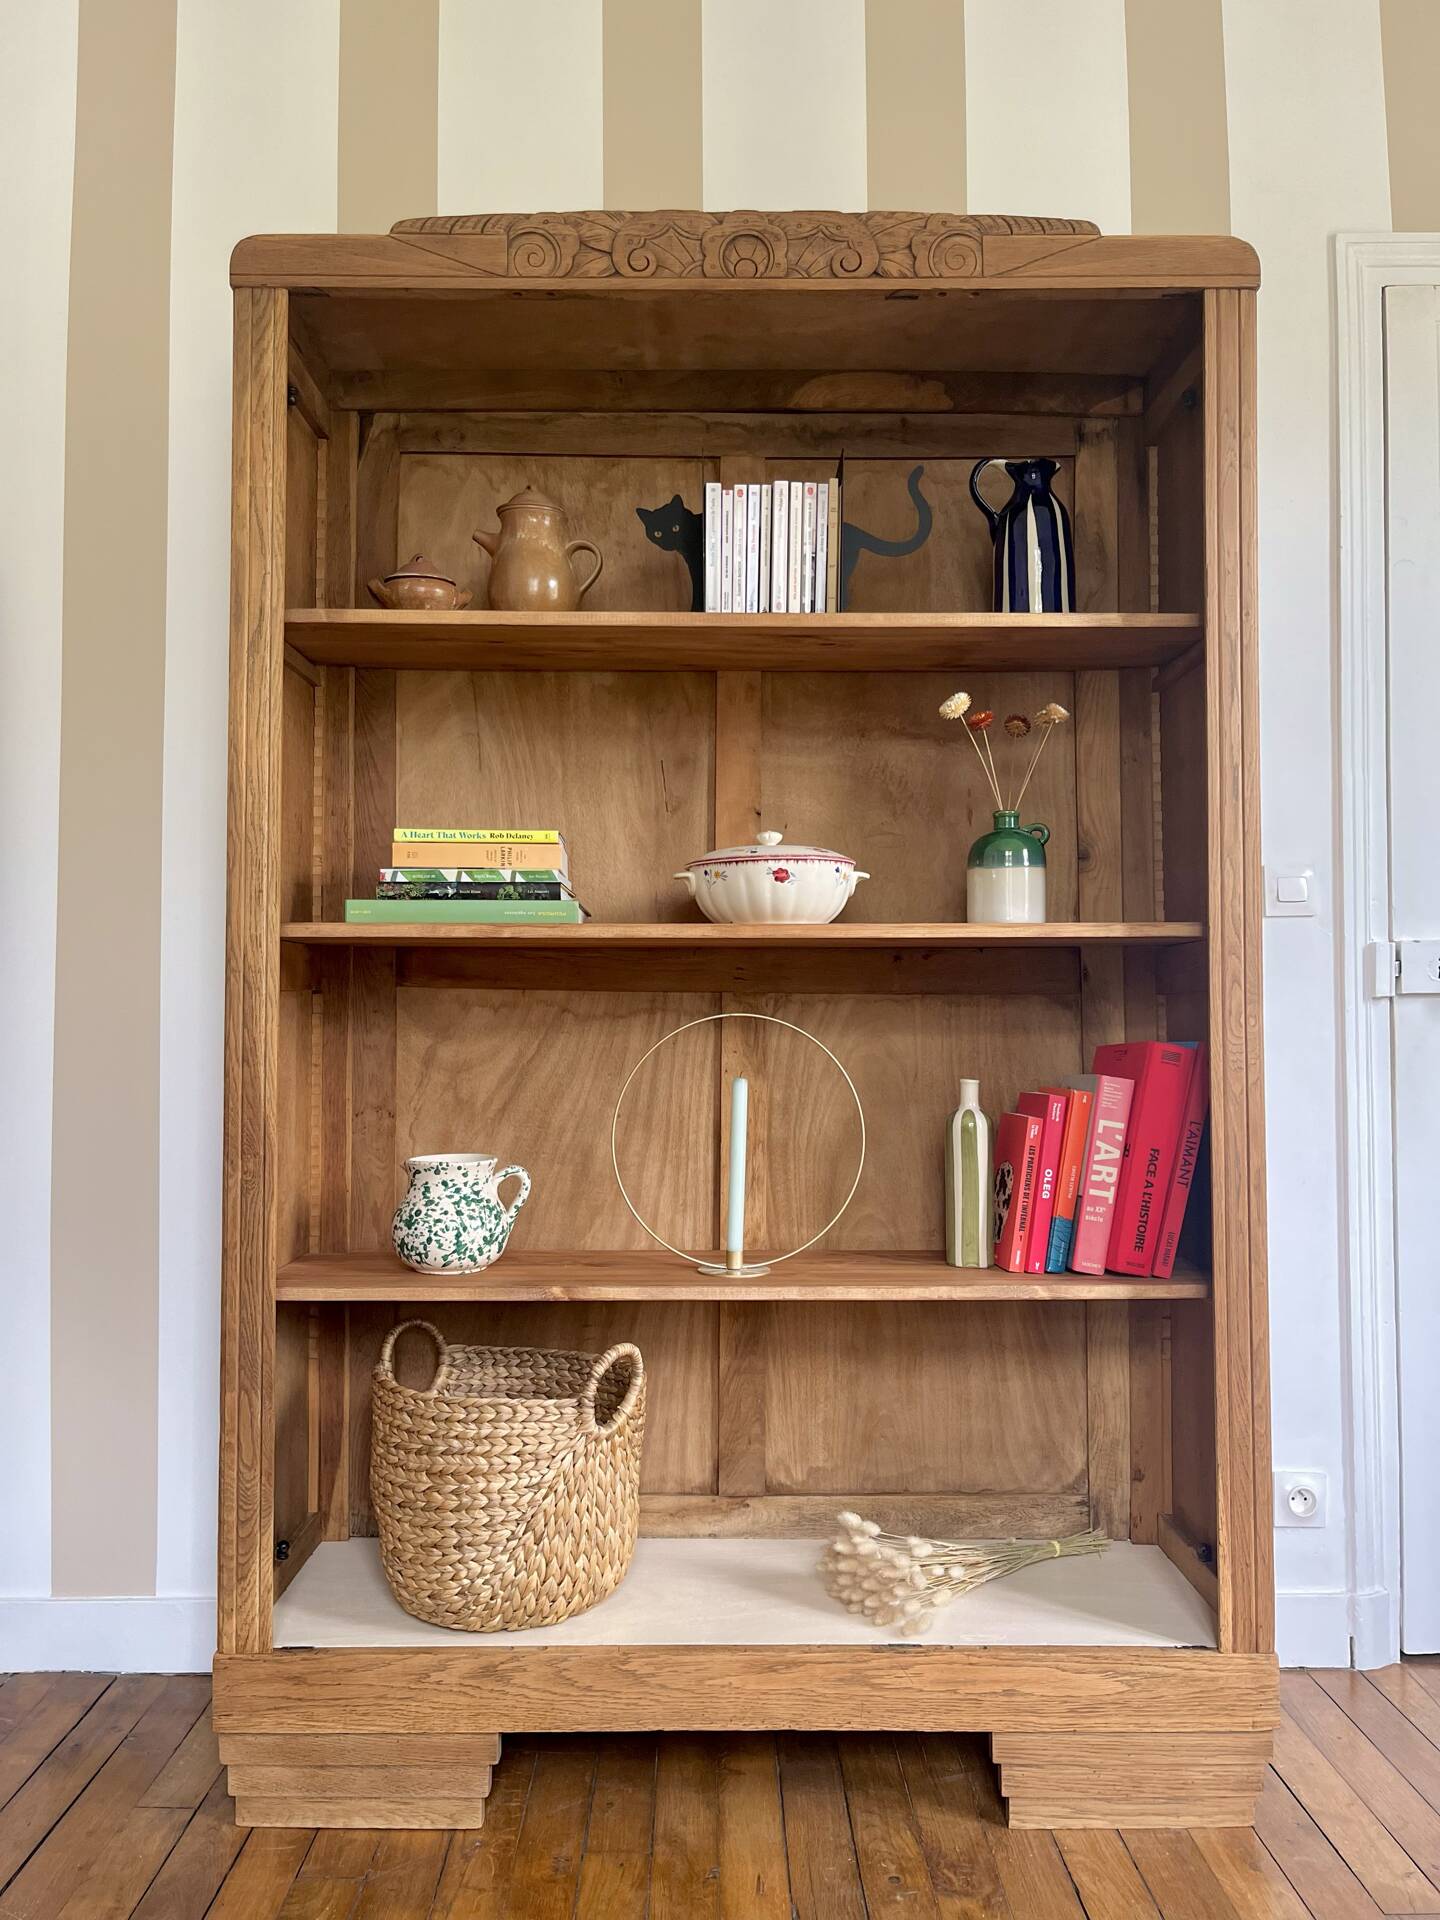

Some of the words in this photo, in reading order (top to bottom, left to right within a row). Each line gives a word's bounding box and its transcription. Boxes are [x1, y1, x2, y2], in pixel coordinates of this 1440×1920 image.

[410, 831, 434, 839] Heart
[436, 831, 457, 839] That
[459, 831, 487, 839] Works
[489, 831, 504, 839] Rob
[506, 832, 534, 840] Delaney
[1028, 1145, 1037, 1156] LES
[1088, 1119, 1126, 1205] L'ART
[1145, 1147, 1161, 1179] FACE
[1175, 1120, 1202, 1190] L'AIMANT
[1023, 1156, 1036, 1191] PRATICIENS
[1041, 1168, 1053, 1200] OLEG
[1022, 1191, 1031, 1200] DE
[1018, 1200, 1030, 1233] L'INFERNAL
[1133, 1191, 1153, 1254] L'HISTOIRE
